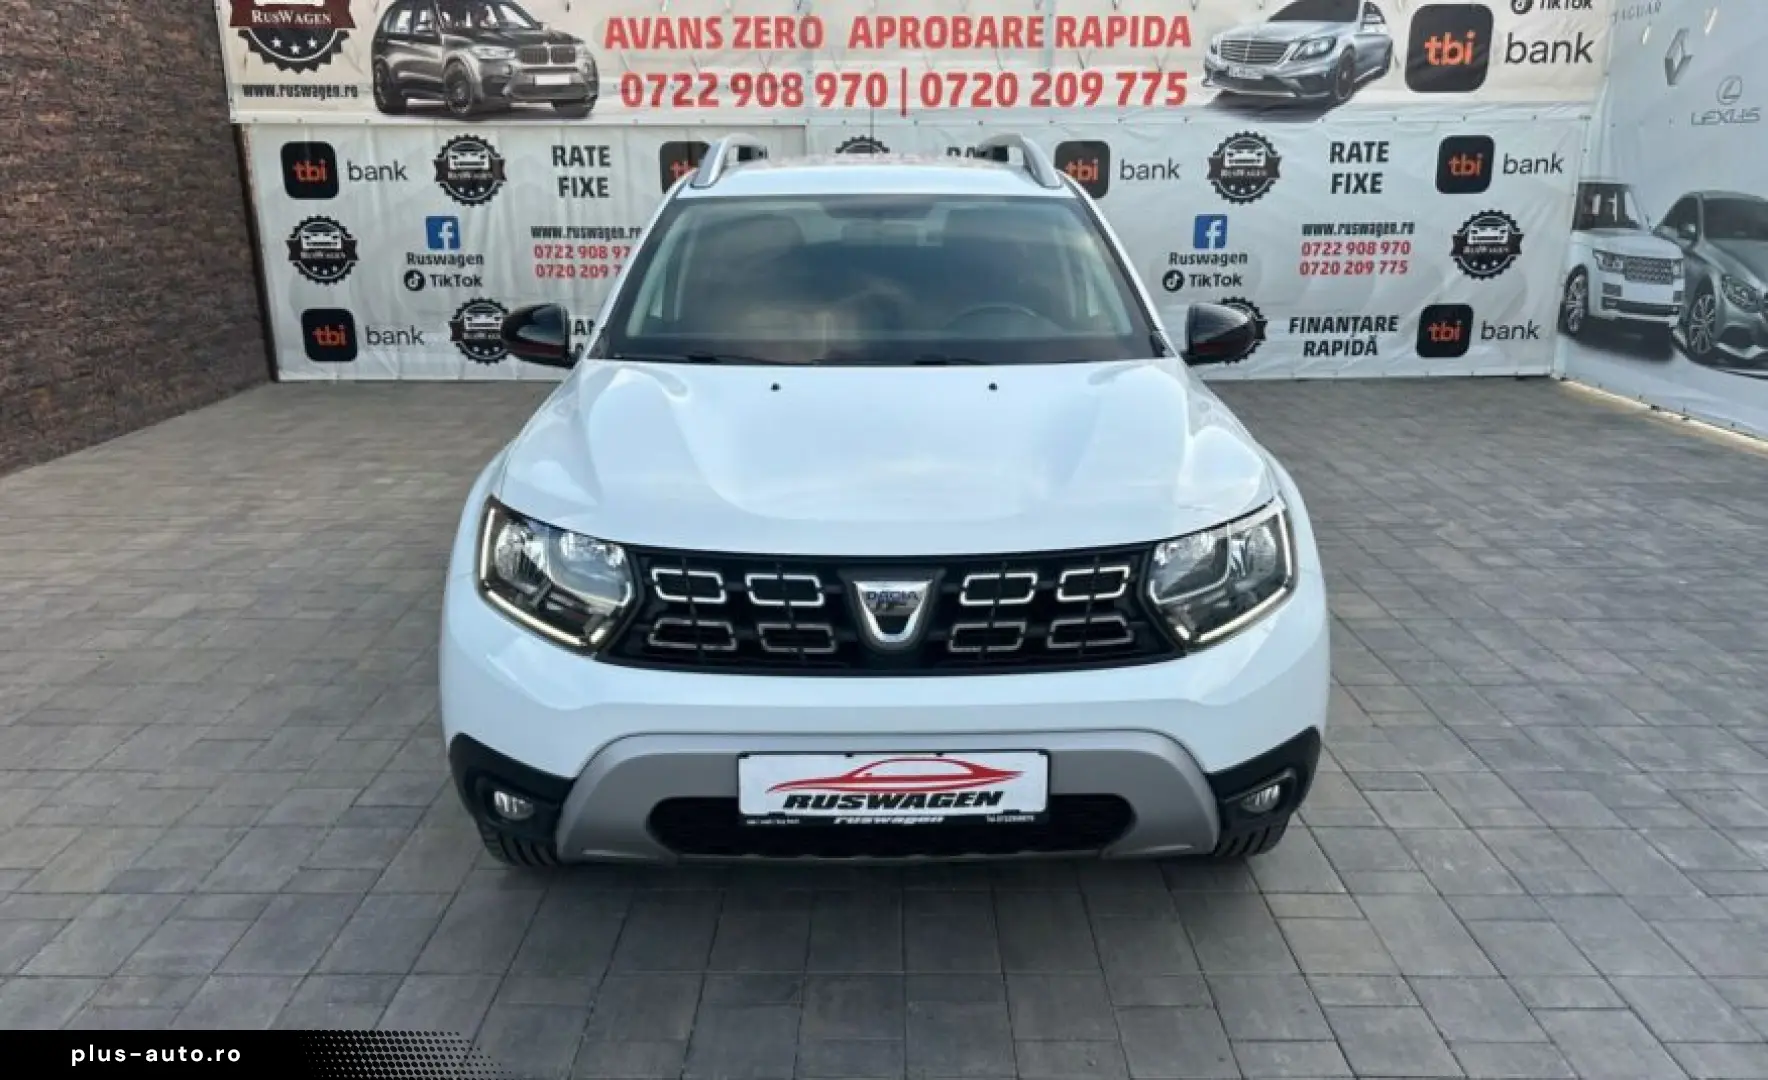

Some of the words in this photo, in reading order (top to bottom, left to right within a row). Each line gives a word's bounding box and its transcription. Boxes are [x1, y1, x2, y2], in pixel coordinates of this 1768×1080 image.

[605, 15, 723, 49] AVANS
[732, 15, 824, 49] ZERO
[849, 15, 1045, 49] APROBARE
[1055, 15, 1192, 48] RAPIDA
[1424, 31, 1476, 65] tbi
[1504, 31, 1594, 65] bank
[241, 83, 359, 101] www.ruswagen.ro
[621, 72, 720, 108] 0722
[730, 72, 804, 108] 908
[814, 72, 889, 108] 970
[919, 72, 1019, 108] 0720
[1030, 72, 1104, 107] 209
[1115, 72, 1188, 107] 775
[1691, 106, 1761, 126] LEXUS
[552, 145, 611, 168] RATE
[1329, 140, 1389, 163] RATE
[293, 160, 328, 183] tbi
[347, 160, 408, 182] bank
[1119, 157, 1180, 180] bank
[1447, 154, 1483, 177] tbi
[1503, 152, 1563, 175] bank
[557, 176, 610, 199] FIXE
[1331, 172, 1383, 195] FIXE
[1301, 221, 1415, 237] www.ruswagen.ro
[406, 252, 484, 267] Ruswagen
[534, 245, 574, 259] 0722
[578, 246, 608, 259] 908
[612, 246, 631, 258] 97
[1168, 252, 1248, 267] Ruswagen
[1302, 241, 1342, 256] 0722
[1346, 241, 1377, 256] 908
[1380, 240, 1411, 255] 970
[535, 264, 576, 278] 0720
[579, 264, 608, 278] 209
[1300, 261, 1341, 276] 0720
[1344, 260, 1374, 275] 209
[1378, 260, 1408, 274] 775
[429, 274, 482, 288] TikTok
[1190, 273, 1242, 288] TikTok
[311, 324, 347, 347] tbi
[366, 326, 425, 346] bank
[1427, 319, 1463, 342] tbi
[1481, 318, 1540, 341] bank
[1303, 334, 1378, 357] RAPIDĂ
[783, 791, 1004, 811] RUSWAGEN
